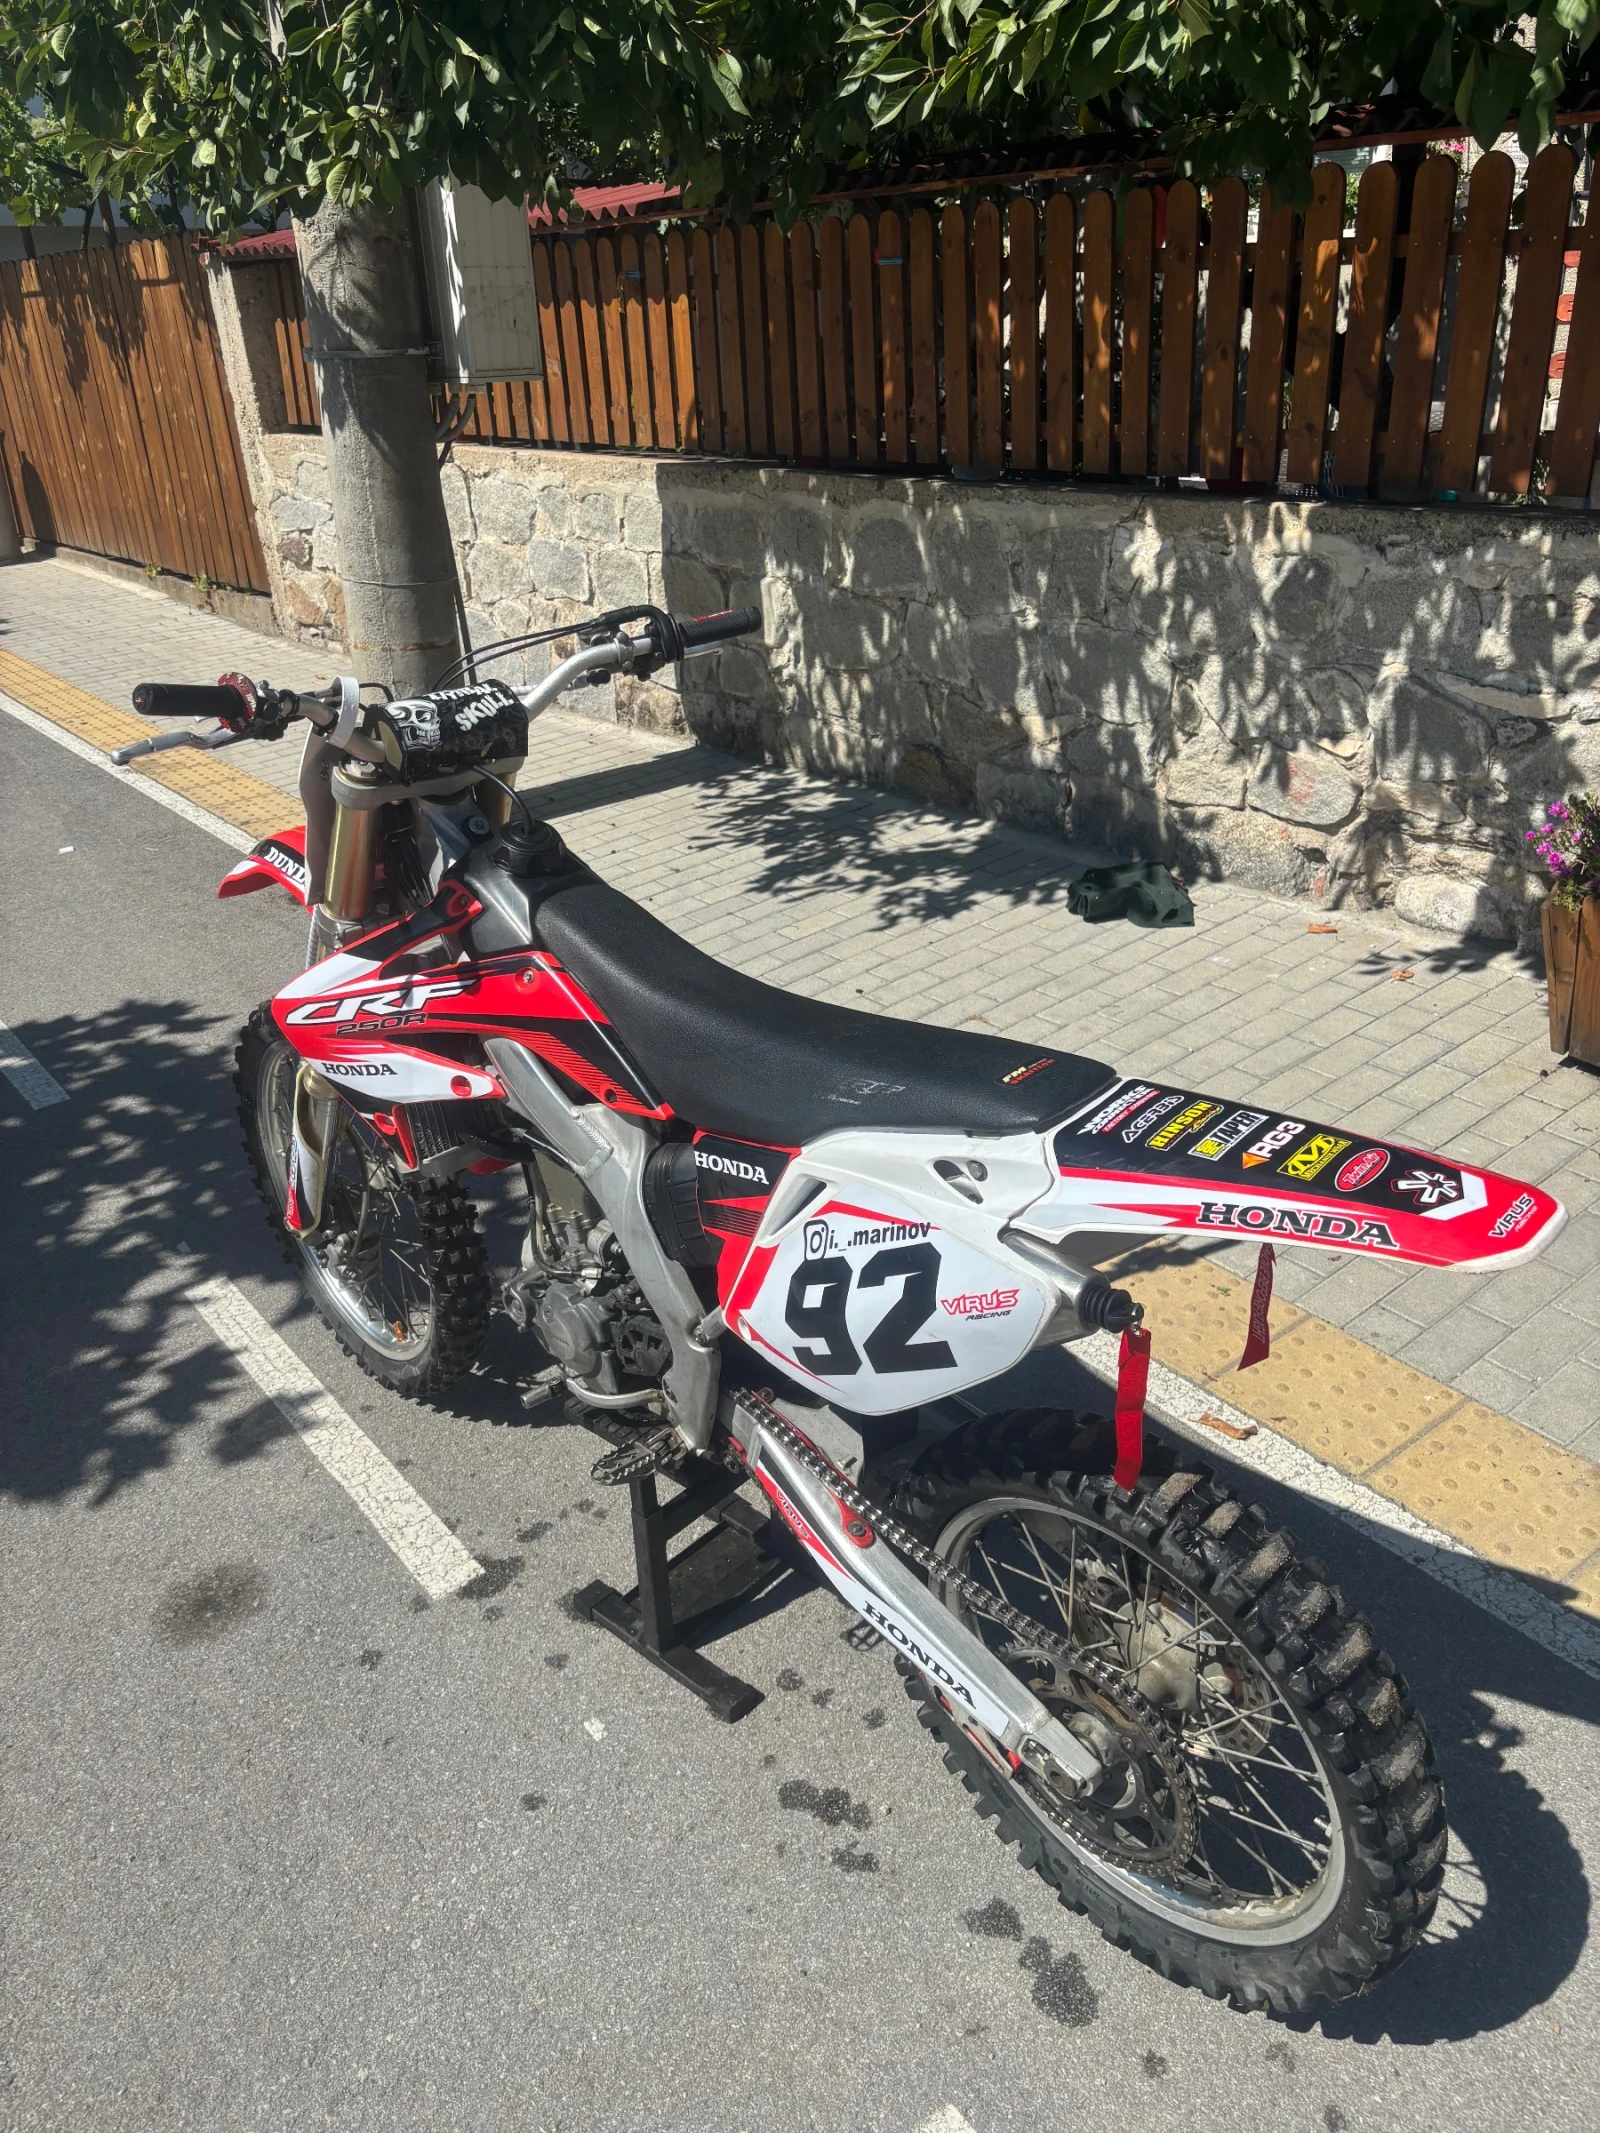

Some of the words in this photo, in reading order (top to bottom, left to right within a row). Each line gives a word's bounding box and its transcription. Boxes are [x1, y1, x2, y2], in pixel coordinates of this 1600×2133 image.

[454, 692, 515, 731] SKULL
[263, 846, 306, 885] DUNL
[285, 977, 479, 1026] CRF
[336, 1012, 428, 1035] 250R
[321, 1062, 398, 1077] HONDA
[1076, 1085, 1147, 1135] WORKS
[1148, 1101, 1213, 1148] HINSON
[1209, 1111, 1260, 1144] TAPER
[1246, 1121, 1306, 1158] RG3
[694, 1151, 769, 1186] HONDA
[1197, 1201, 1400, 1249] HONDA
[1487, 1192, 1535, 1238] VIRUS
[1259, 1243, 1272, 1278] EMOVE
[785, 1242, 958, 1376] 92
[941, 1289, 1020, 1315] VIRUS
[965, 1309, 1012, 1322] RACING
[863, 1600, 977, 1710] HONDA
